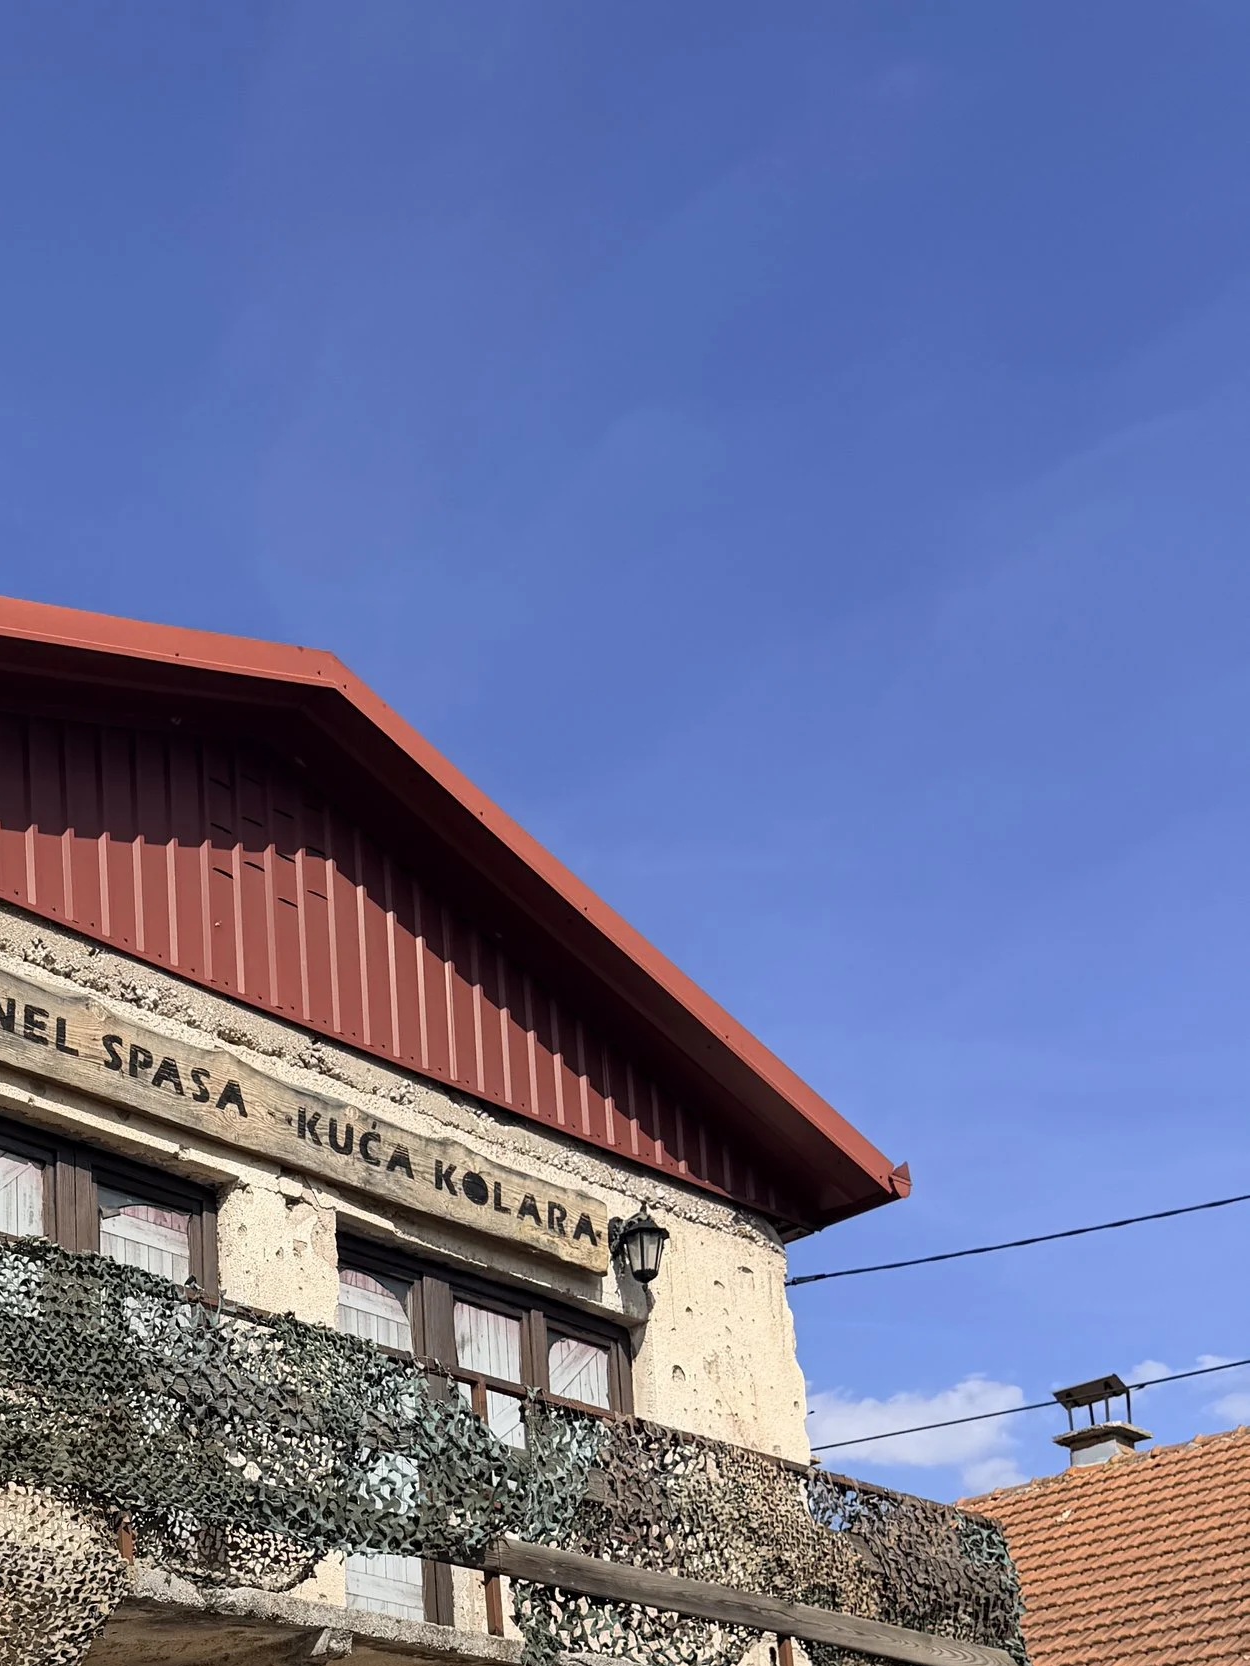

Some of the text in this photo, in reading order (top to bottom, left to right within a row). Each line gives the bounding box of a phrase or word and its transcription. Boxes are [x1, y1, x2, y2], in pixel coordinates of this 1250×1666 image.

[102, 1034, 249, 1118] SPASA
[297, 1105, 415, 1180] KUĆA
[434, 1158, 598, 1247] KOLARA
